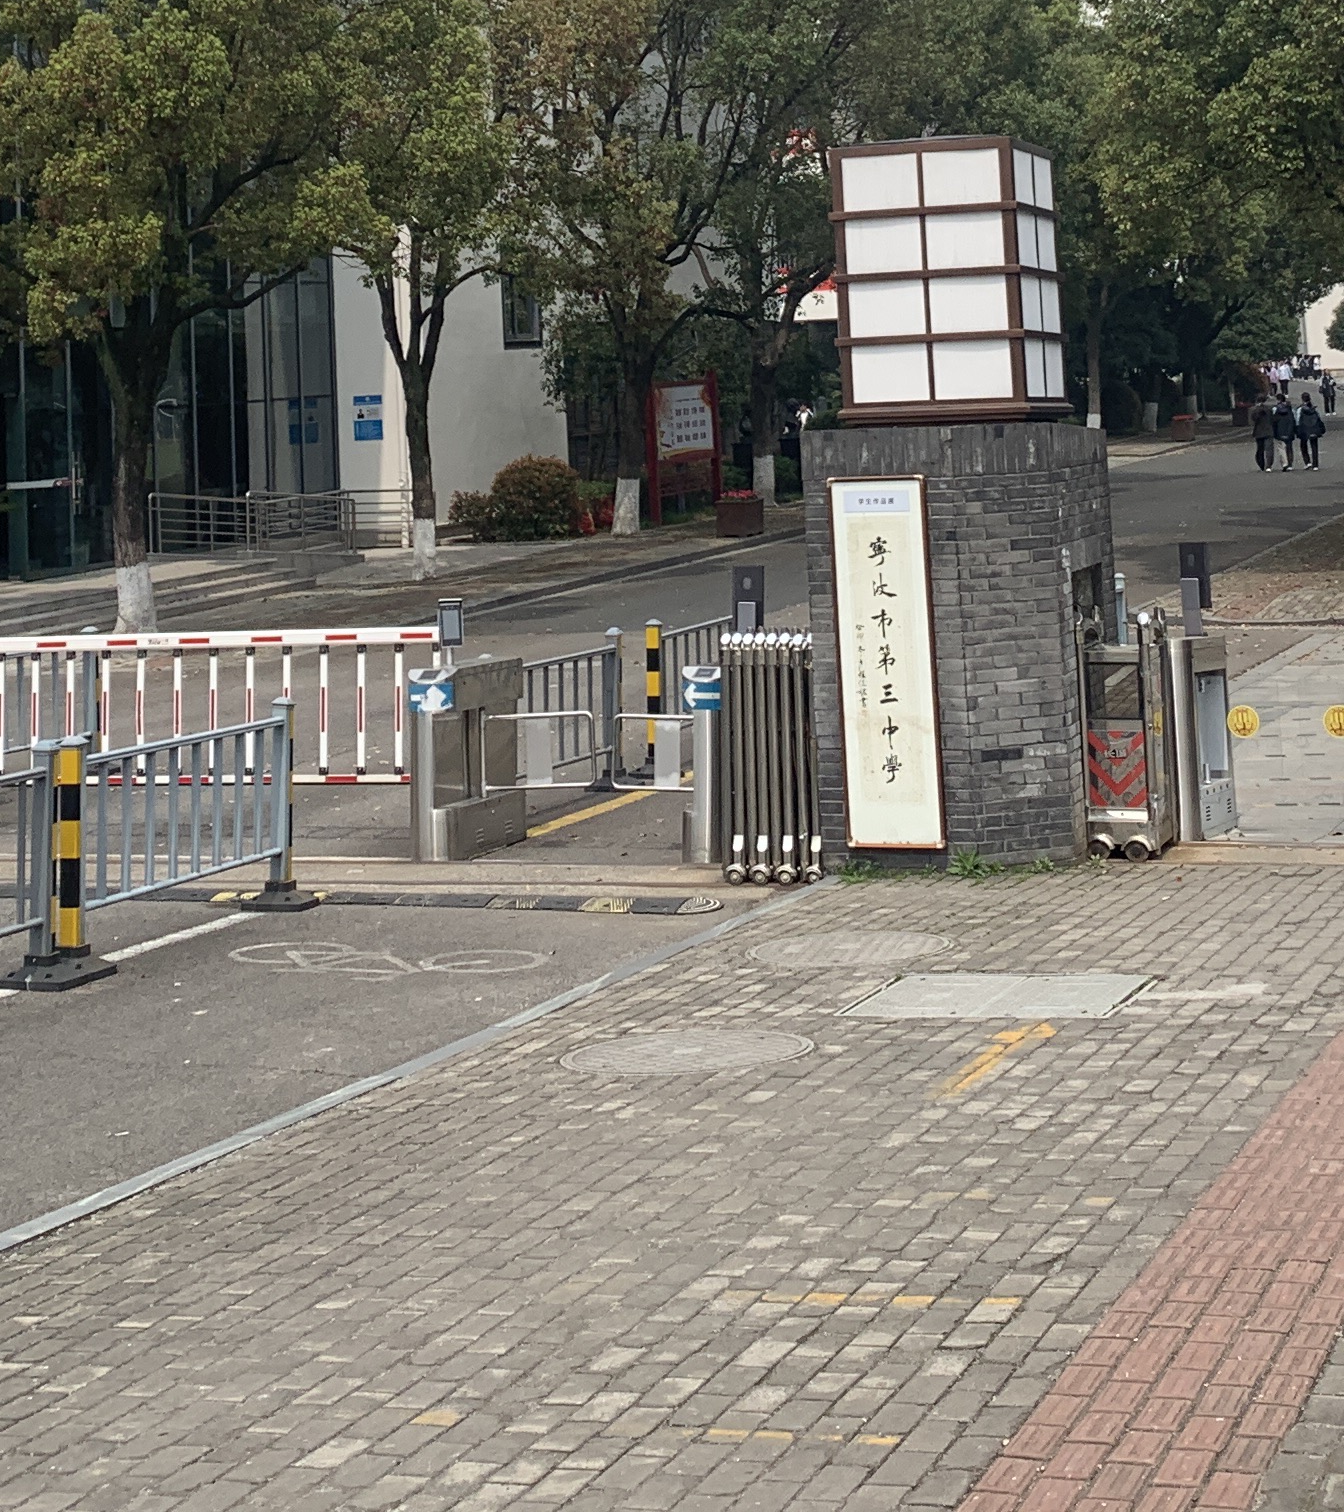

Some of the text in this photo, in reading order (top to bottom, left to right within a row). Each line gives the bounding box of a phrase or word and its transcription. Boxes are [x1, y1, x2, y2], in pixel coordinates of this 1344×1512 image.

[858, 497, 895, 505] 学生作品展
